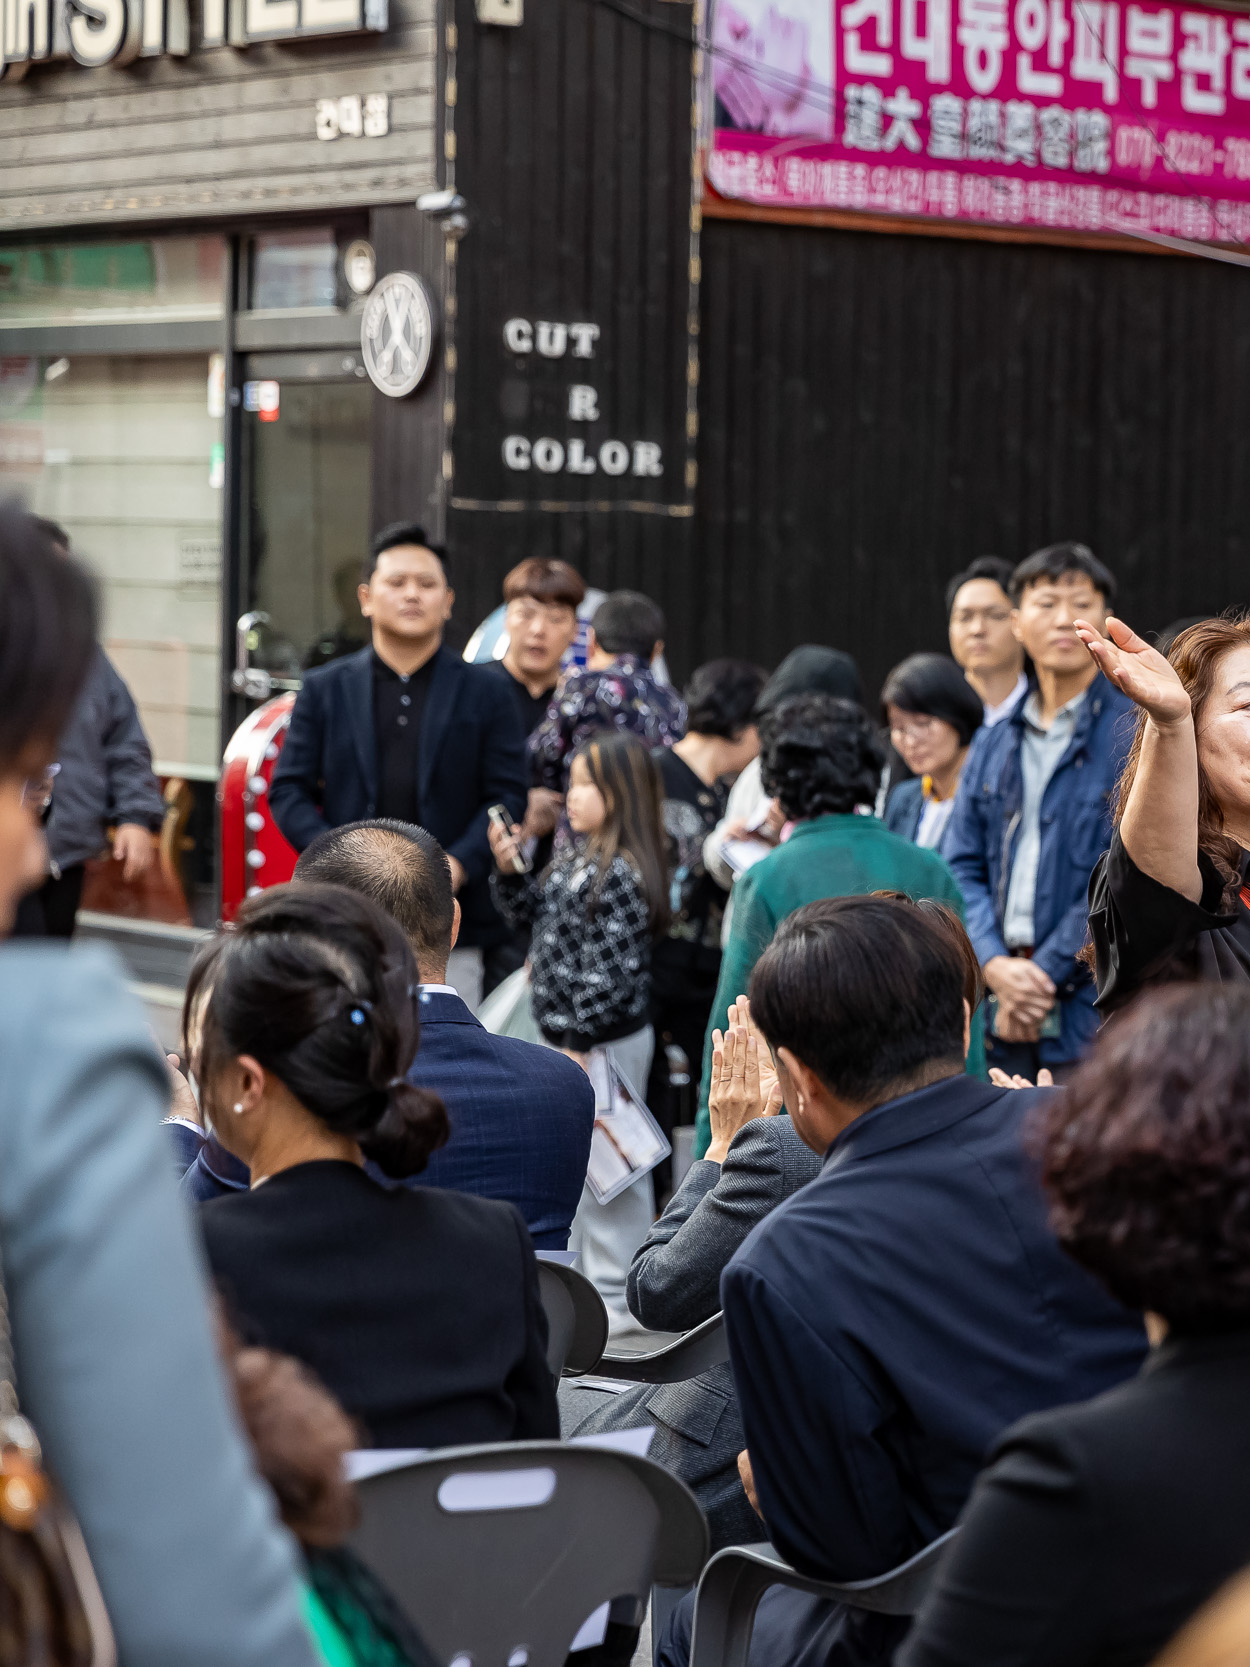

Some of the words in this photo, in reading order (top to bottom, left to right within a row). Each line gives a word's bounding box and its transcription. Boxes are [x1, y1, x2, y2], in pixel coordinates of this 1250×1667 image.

[502, 317, 601, 359] CUT
[567, 384, 600, 421] R
[502, 434, 664, 478] COLOR
